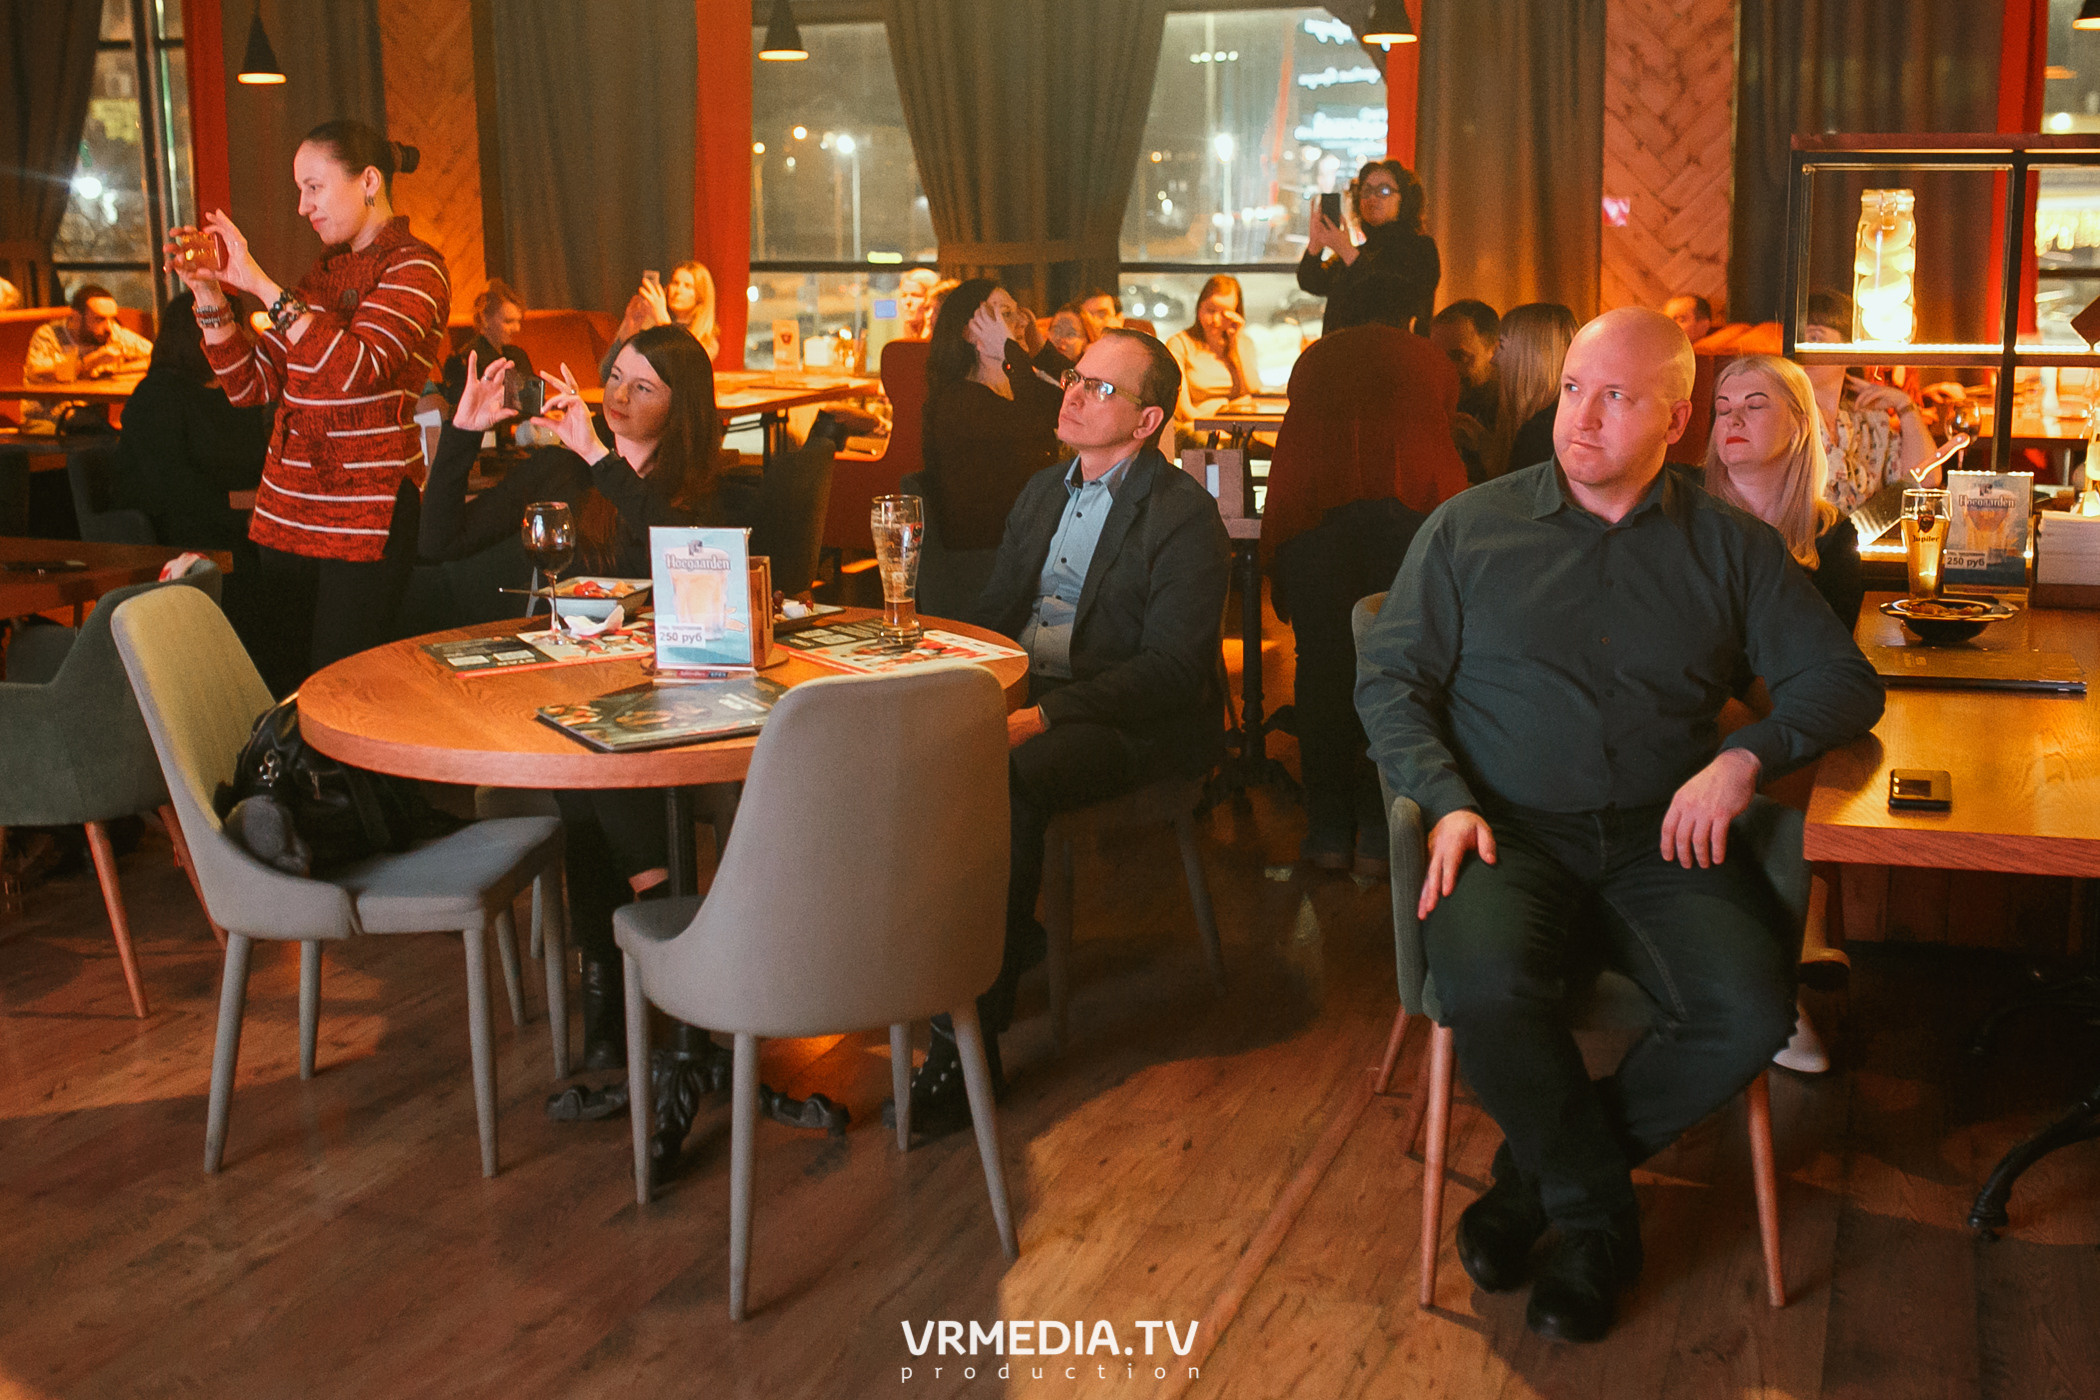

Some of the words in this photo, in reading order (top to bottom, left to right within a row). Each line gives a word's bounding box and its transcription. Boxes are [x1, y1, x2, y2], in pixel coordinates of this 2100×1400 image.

[1959, 494, 2016, 509] Hoegaarden
[1912, 534, 1940, 543] Jupiler
[665, 553, 731, 571] Hoegaarden
[1947, 556, 1964, 566] 250
[1967, 558, 1985, 568] руб
[659, 631, 679, 642] 250
[682, 632, 703, 645] руб
